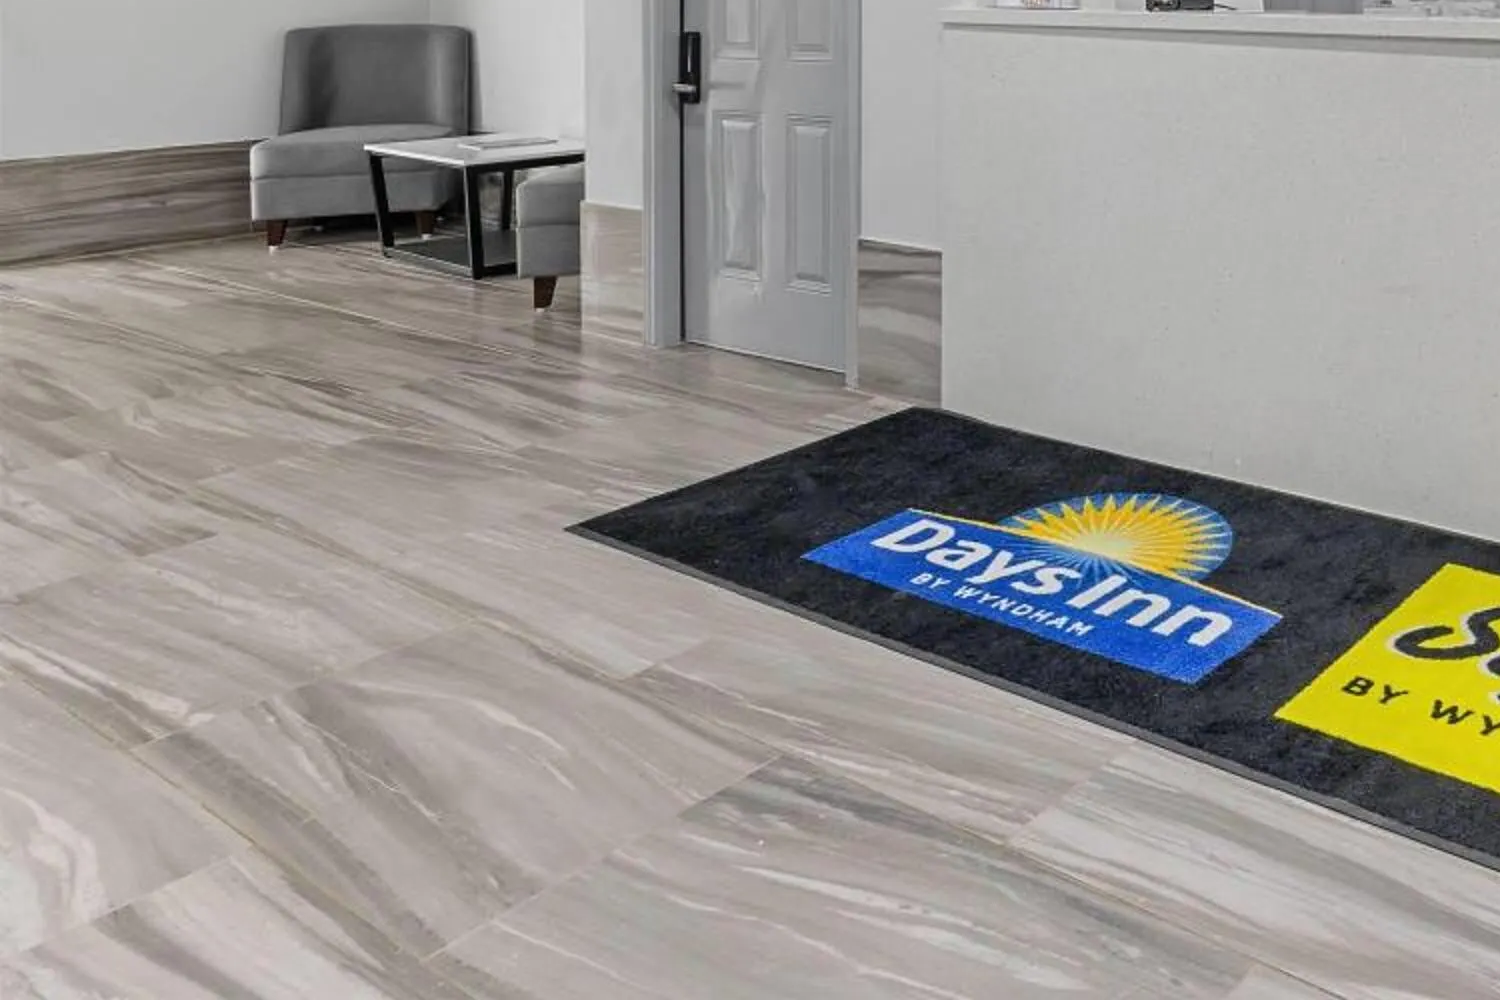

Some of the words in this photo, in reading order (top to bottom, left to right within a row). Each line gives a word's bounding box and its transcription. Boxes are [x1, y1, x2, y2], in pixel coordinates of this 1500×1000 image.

[871, 518, 1084, 596] Days
[1067, 567, 1233, 647] Inn
[910, 572, 952, 591] BY
[955, 585, 1095, 638] WYNDHAM
[1341, 676, 1410, 705] BY
